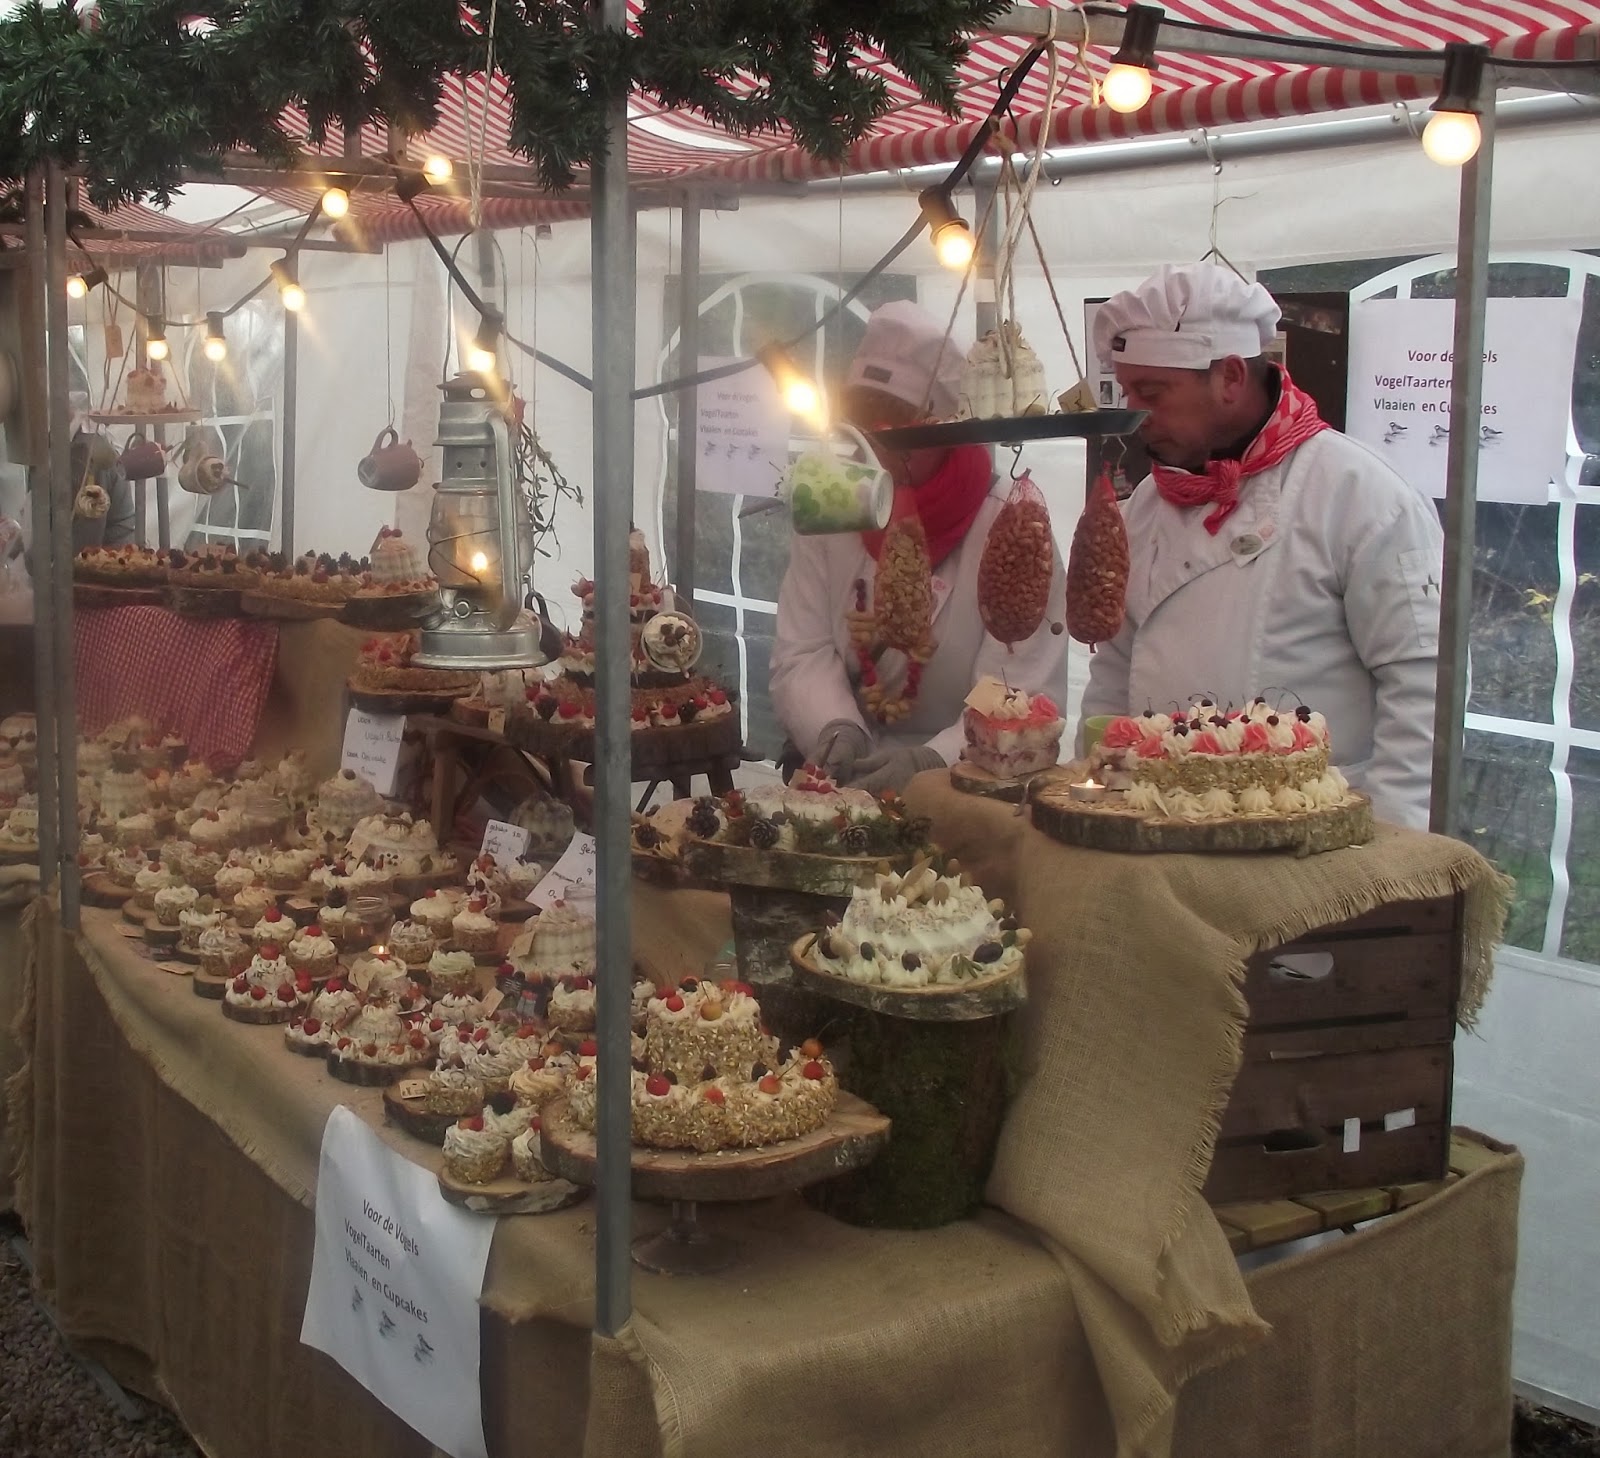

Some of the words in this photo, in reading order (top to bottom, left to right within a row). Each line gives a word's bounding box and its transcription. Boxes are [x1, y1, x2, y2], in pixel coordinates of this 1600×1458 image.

[1408, 350, 1437, 362] Voor
[1440, 350, 1453, 362] de
[1374, 398, 1416, 411] Vlaaien
[1421, 402, 1436, 412] en
[345, 1217, 390, 1270] VogelTaarten
[363, 1199, 383, 1225] Voor
[383, 1216, 394, 1235] de
[395, 1223, 419, 1256] Vogels
[345, 1246, 368, 1282] Vlaaien
[372, 1276, 382, 1293] en
[383, 1283, 428, 1324] Cupcakes
